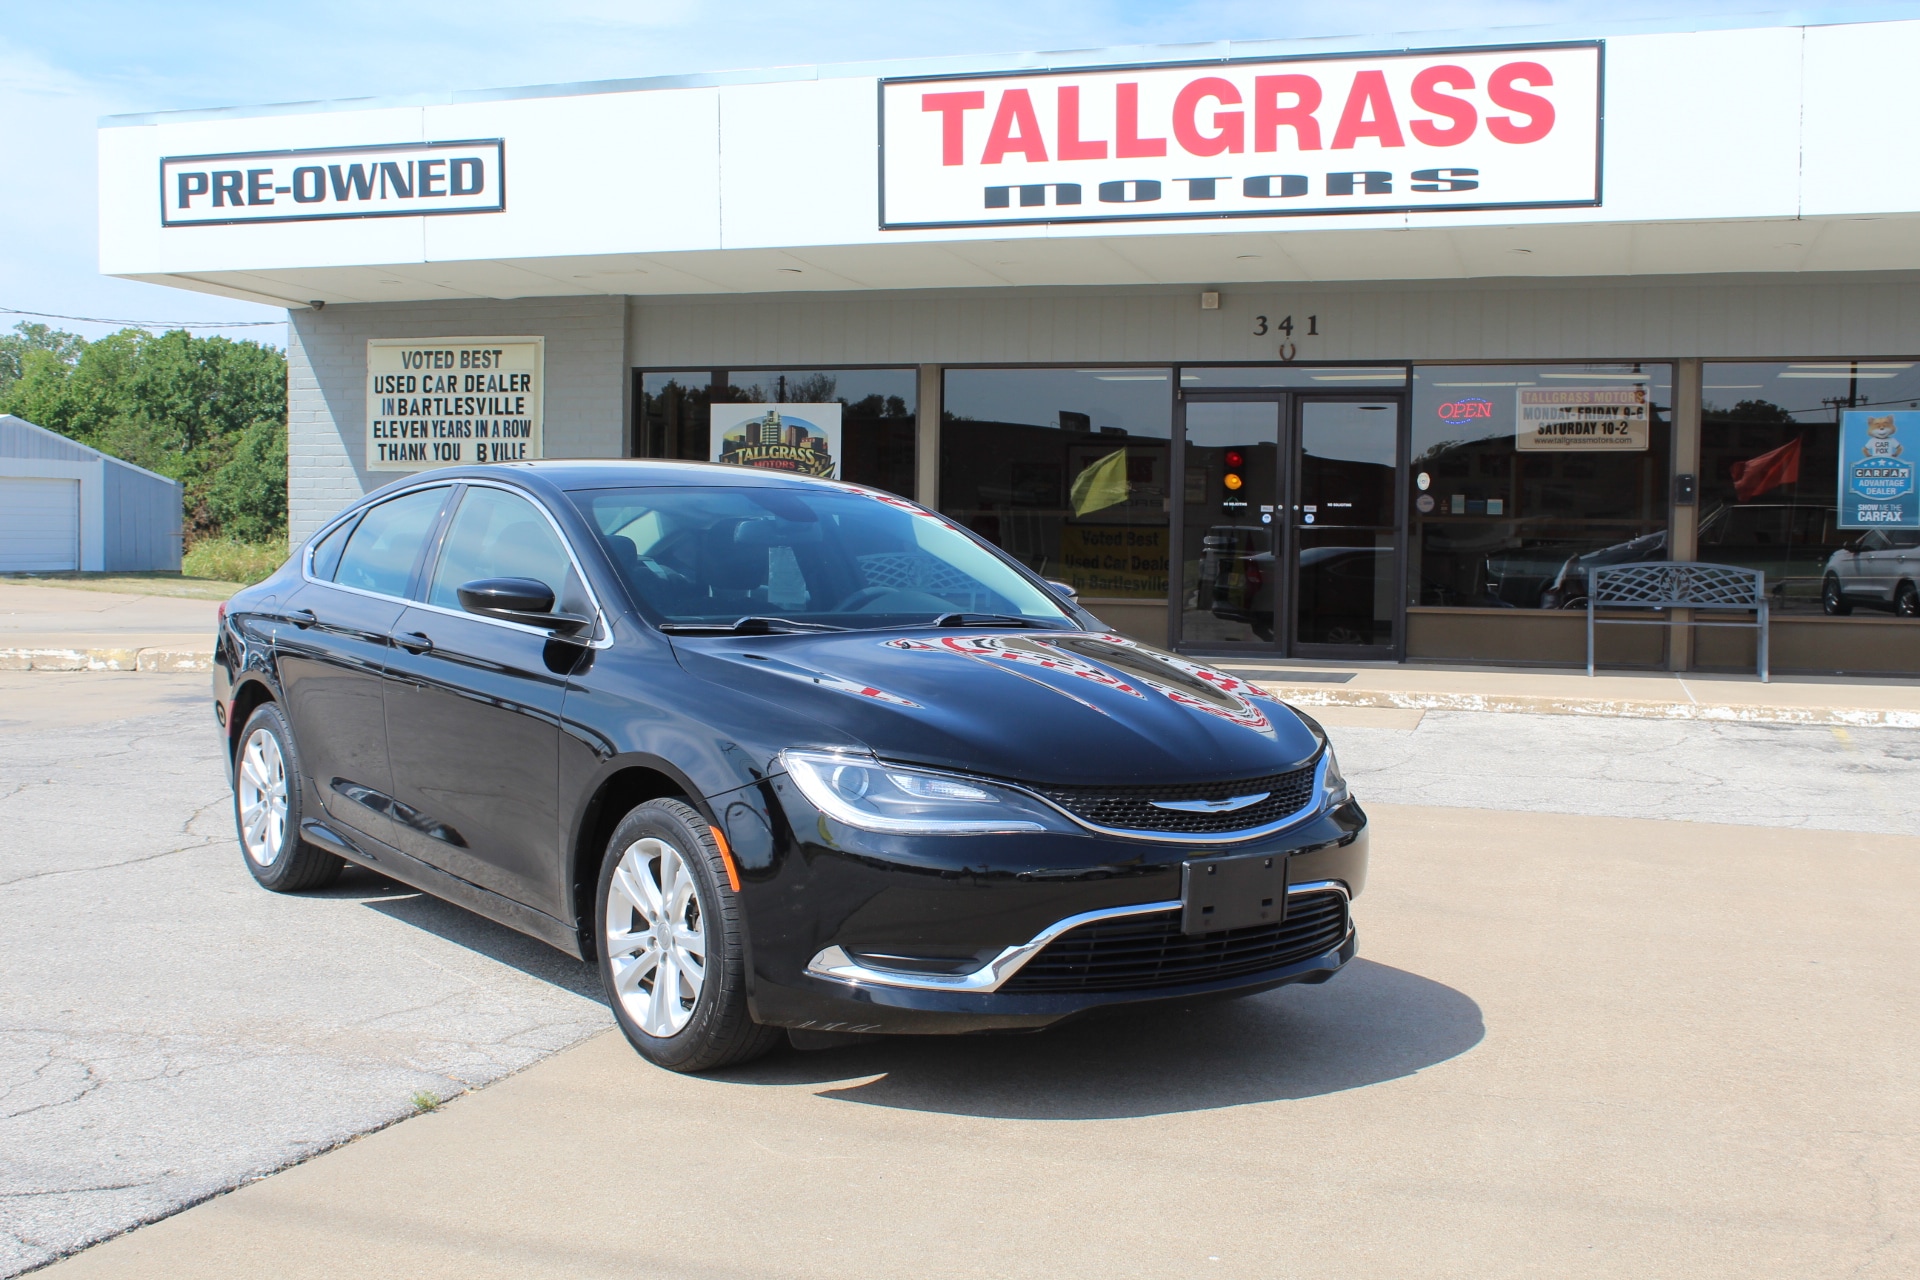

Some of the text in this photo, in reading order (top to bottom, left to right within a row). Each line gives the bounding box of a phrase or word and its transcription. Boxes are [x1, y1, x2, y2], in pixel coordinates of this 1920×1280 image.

[921, 61, 1556, 166] TALLGRASS
[177, 157, 484, 209] PRE-OWNED
[402, 350, 502, 369] VOTED BEST
[374, 374, 531, 394] USED CAR DEALER
[1524, 391, 1644, 403] TALLGRASS MOTORS
[382, 396, 525, 416] IN BARTLESVILLE
[1437, 401, 1493, 419] OPEN
[373, 419, 531, 438] ELEVEN YEARS IN A ROW
[1538, 421, 1628, 435] SATURDAY 10-2
[1534, 436, 1632, 446] www.tallgrassmotors.com
[378, 443, 427, 461] THANK
[433, 442, 461, 461] YOU
[735, 445, 816, 466] TALLGRASS
[753, 459, 796, 469] MOTORS
[1856, 468, 1908, 477] CARFAX
[1858, 479, 1905, 487] ADVANTAGE
[1866, 487, 1897, 495] DEALER
[1857, 503, 1879, 511] SHOW
[1857, 511, 1903, 522] CARFAX
[1082, 530, 1159, 547] Voted Best
[1065, 554, 1170, 571] Used Car Deale
